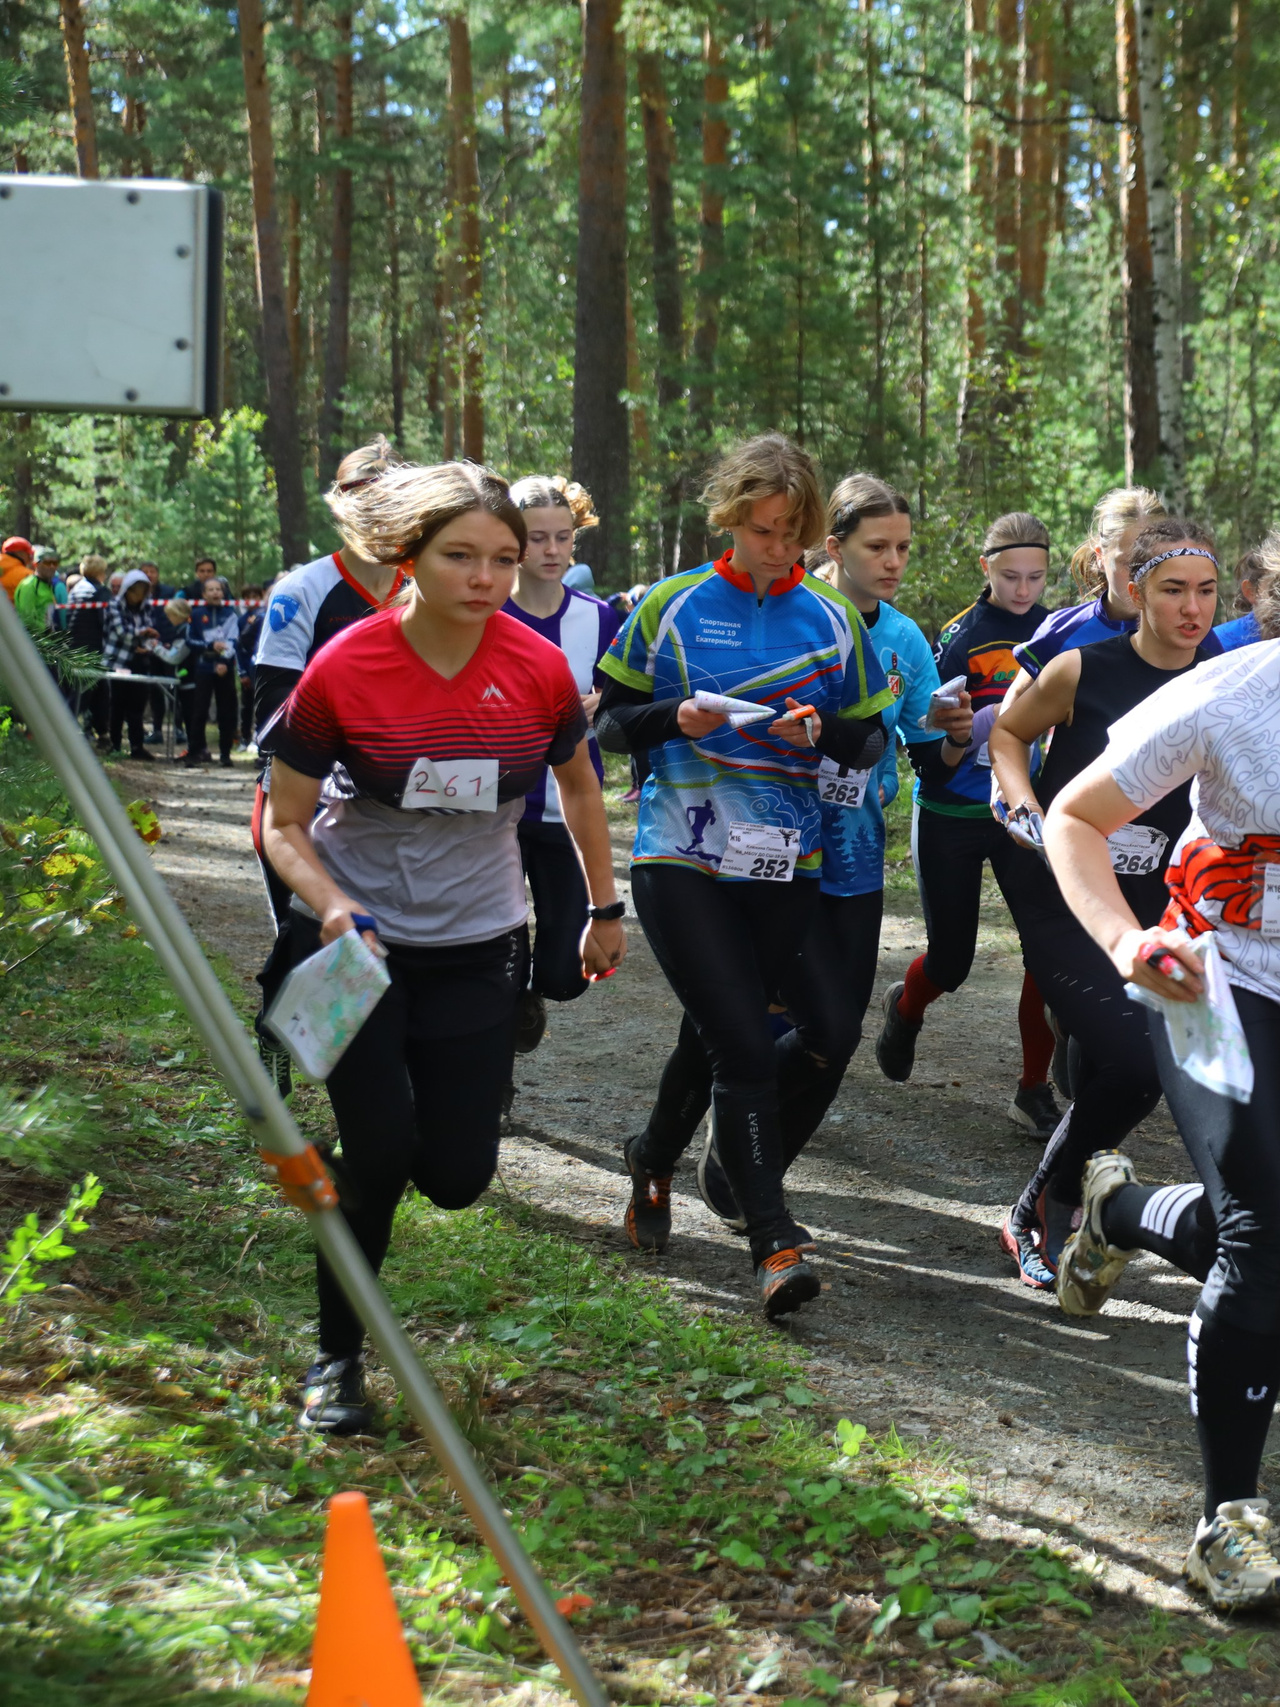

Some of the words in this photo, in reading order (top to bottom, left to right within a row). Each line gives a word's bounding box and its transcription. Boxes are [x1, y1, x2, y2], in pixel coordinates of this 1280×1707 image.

[699, 617, 742, 628] Спортивная
[702, 628, 725, 636] школа
[726, 629, 736, 637] 19
[695, 634, 743, 647] Екатеринбург
[414, 771, 482, 797] 261
[821, 782, 860, 806] 262
[749, 857, 790, 880] 252
[1112, 853, 1154, 873] 264
[748, 1112, 763, 1165] ARSWEAR
